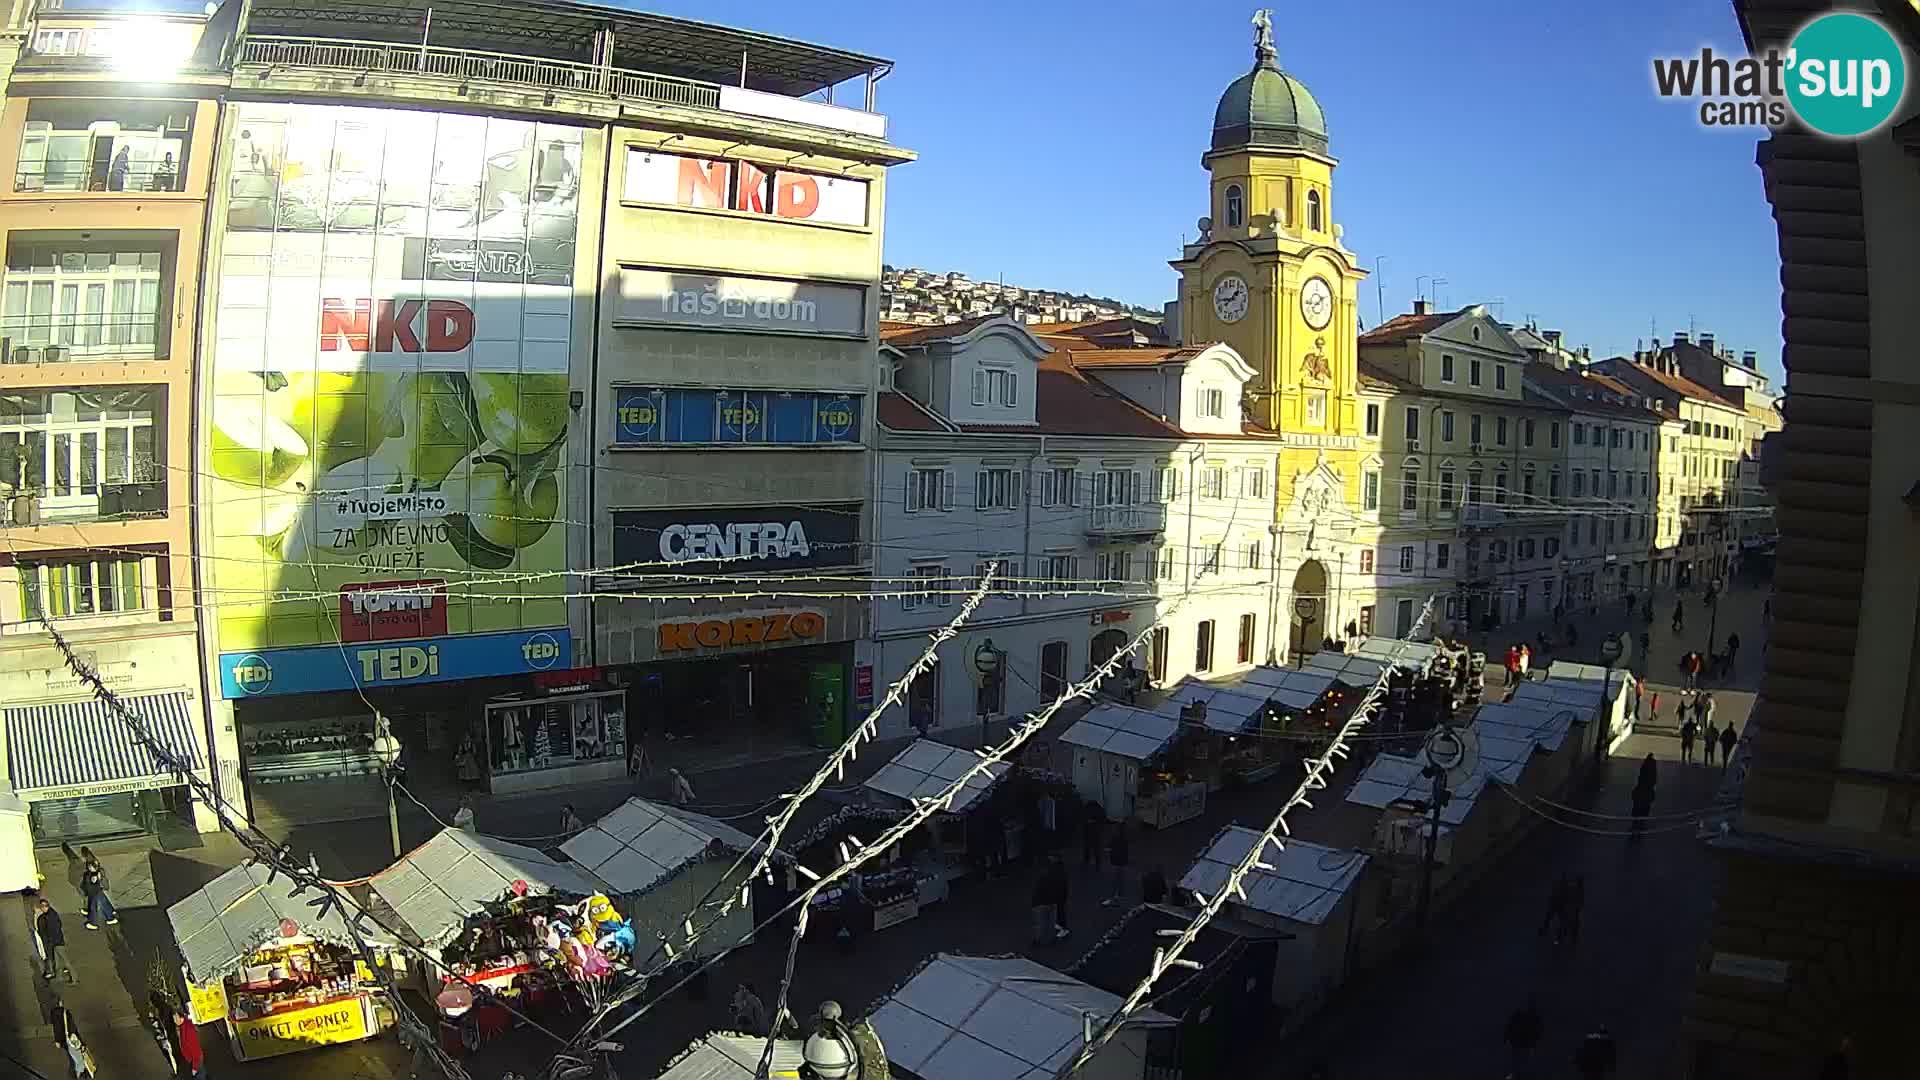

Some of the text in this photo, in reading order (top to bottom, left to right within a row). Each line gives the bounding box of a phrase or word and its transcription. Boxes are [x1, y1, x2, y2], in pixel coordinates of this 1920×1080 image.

[677, 158, 820, 219] NKD
[661, 282, 817, 322] naš dom
[320, 298, 476, 353] NKD
[618, 408, 658, 425] TEDi
[818, 411, 853, 427] TEDi
[337, 496, 446, 516] #TvojeMisto
[332, 522, 450, 549] ZA DNEVNO
[658, 520, 811, 563] CENTRA
[658, 611, 826, 652] KORZO
[357, 645, 440, 682] TEDi
[521, 641, 560, 660] TEDi
[231, 666, 273, 684] TEDi
